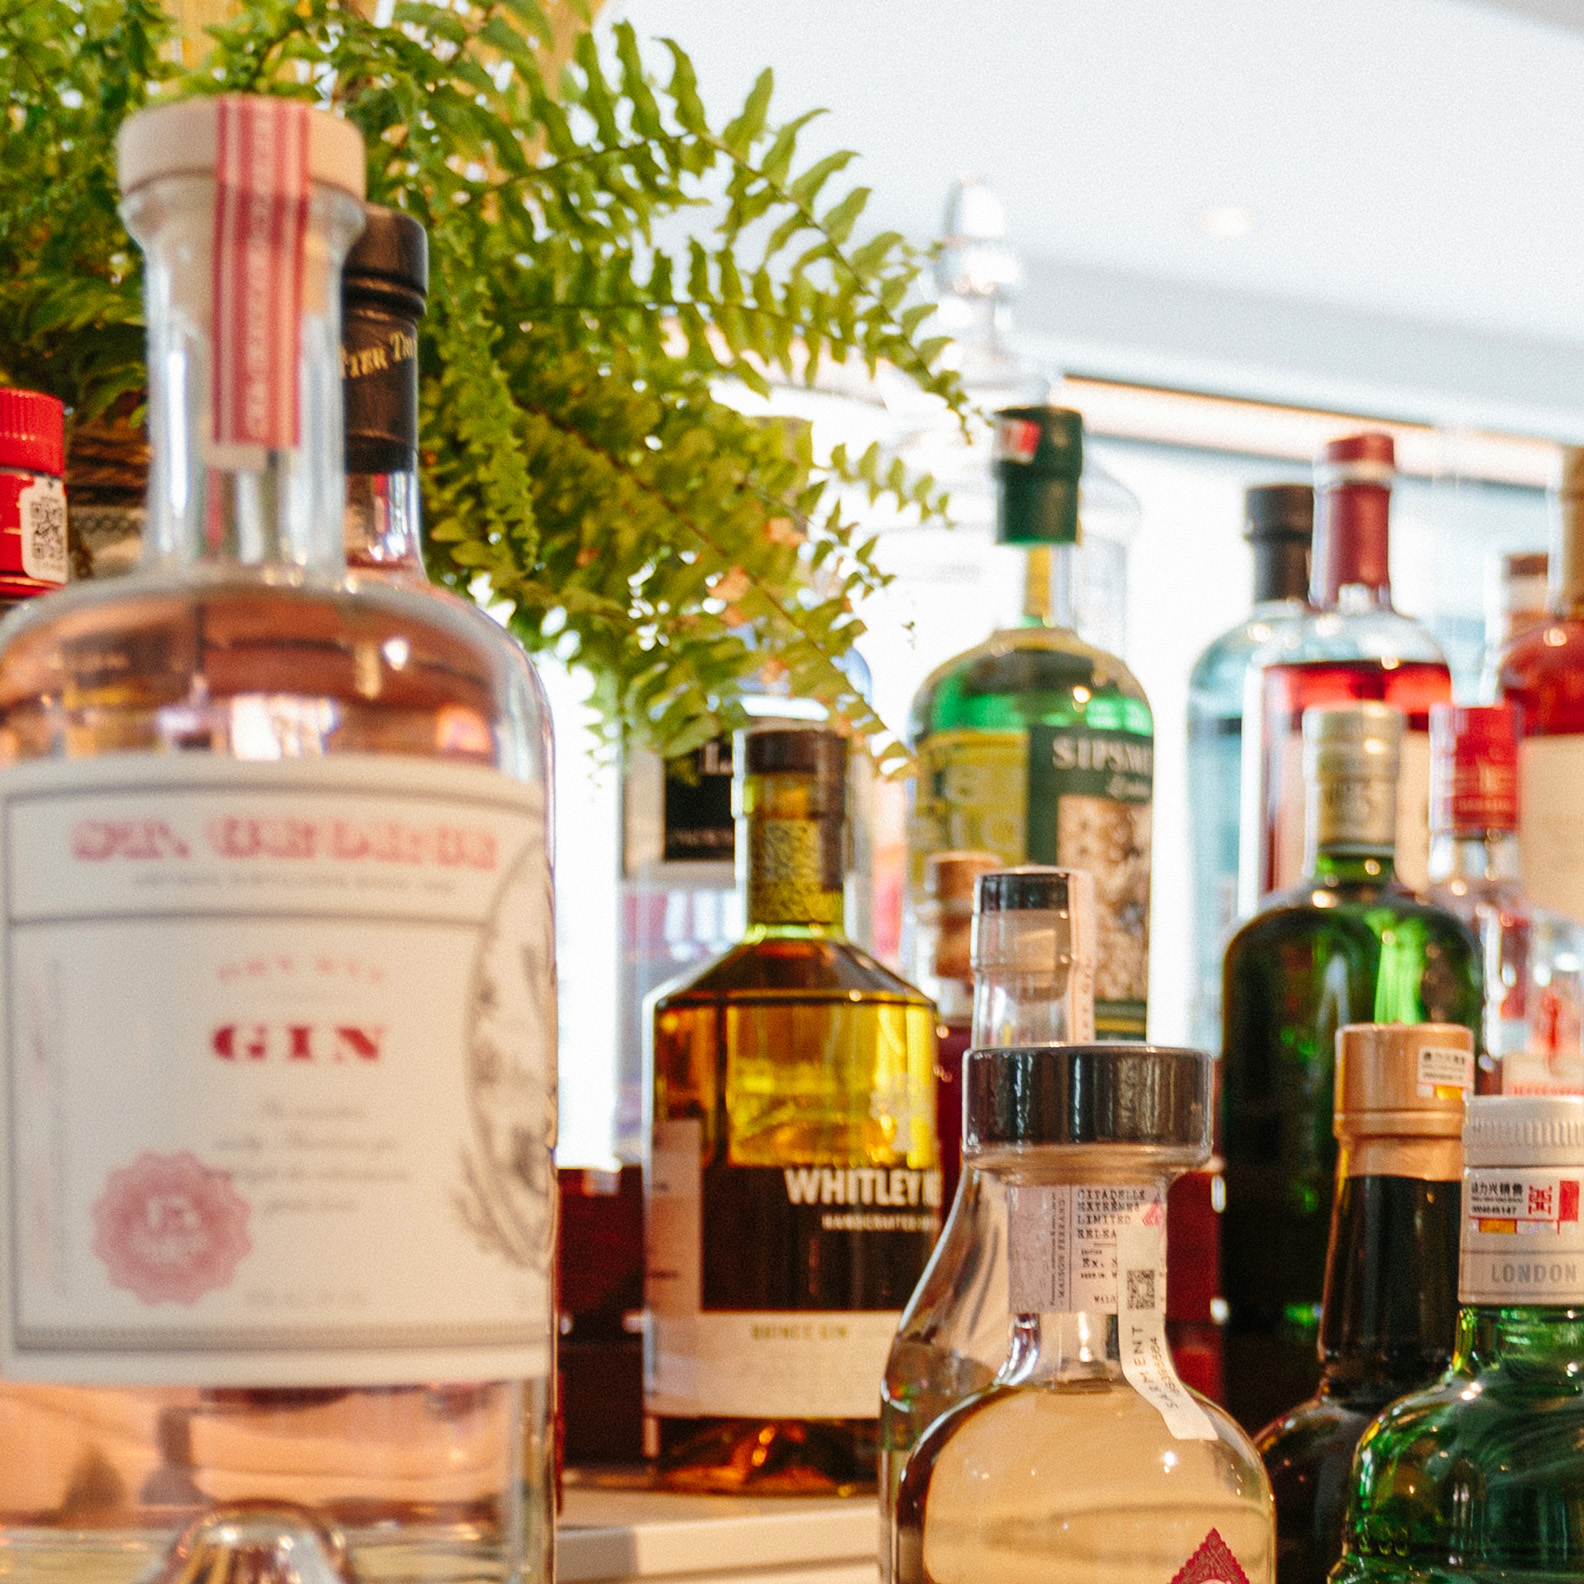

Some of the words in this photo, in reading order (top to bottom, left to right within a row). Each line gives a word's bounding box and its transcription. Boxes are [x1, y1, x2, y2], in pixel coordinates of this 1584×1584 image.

[210, 1022, 386, 1063] GIN
[1076, 1189, 1146, 1202] CITADELLE
[1076, 1214, 1132, 1226] LIMITED
[1491, 1263, 1577, 1285] LONDON
